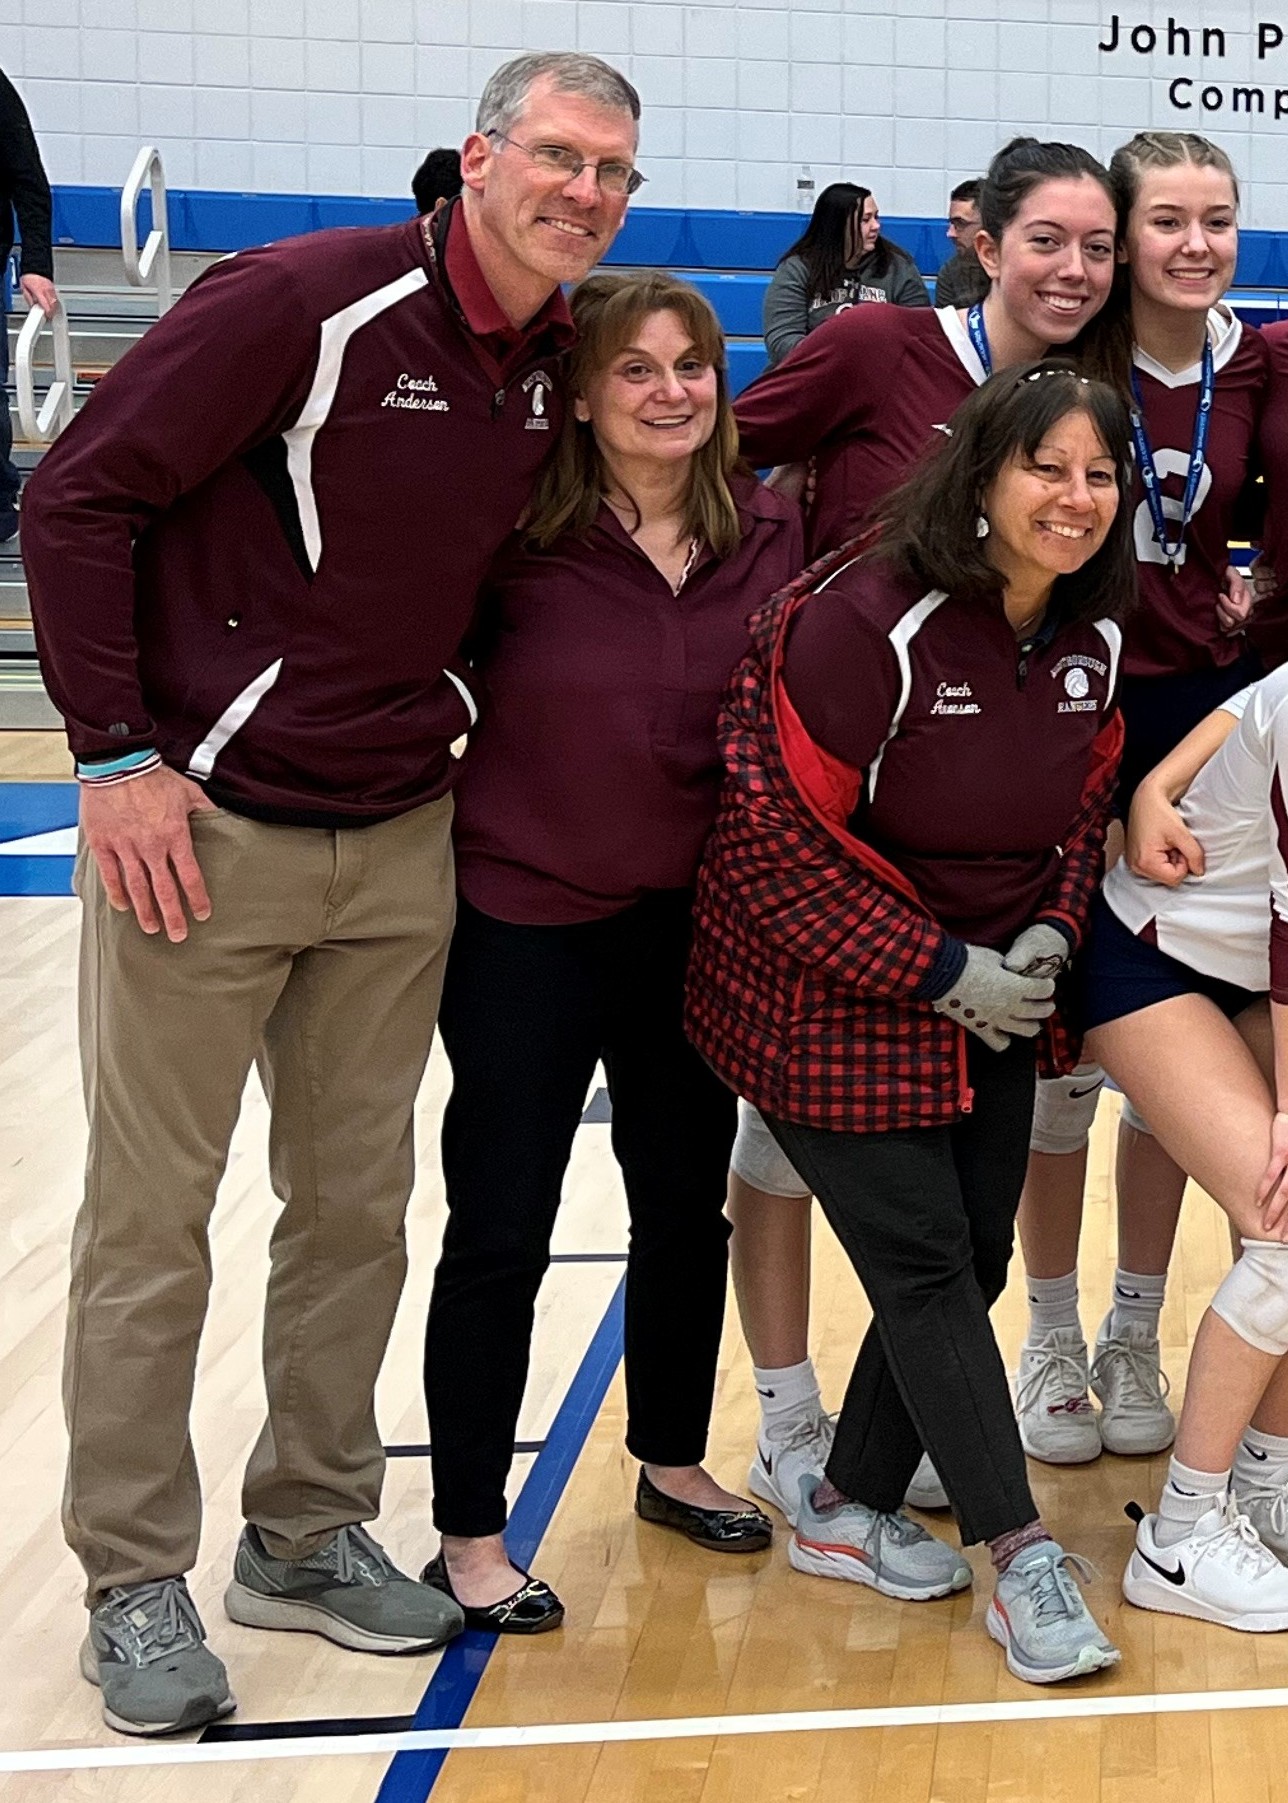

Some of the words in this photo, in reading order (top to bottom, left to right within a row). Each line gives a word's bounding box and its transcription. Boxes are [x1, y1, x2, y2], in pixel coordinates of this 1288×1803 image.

[1098, 14, 1227, 58] John
[397, 373, 438, 392] Coach
[381, 391, 449, 412] Anderson
[936, 682, 972, 697] Coach
